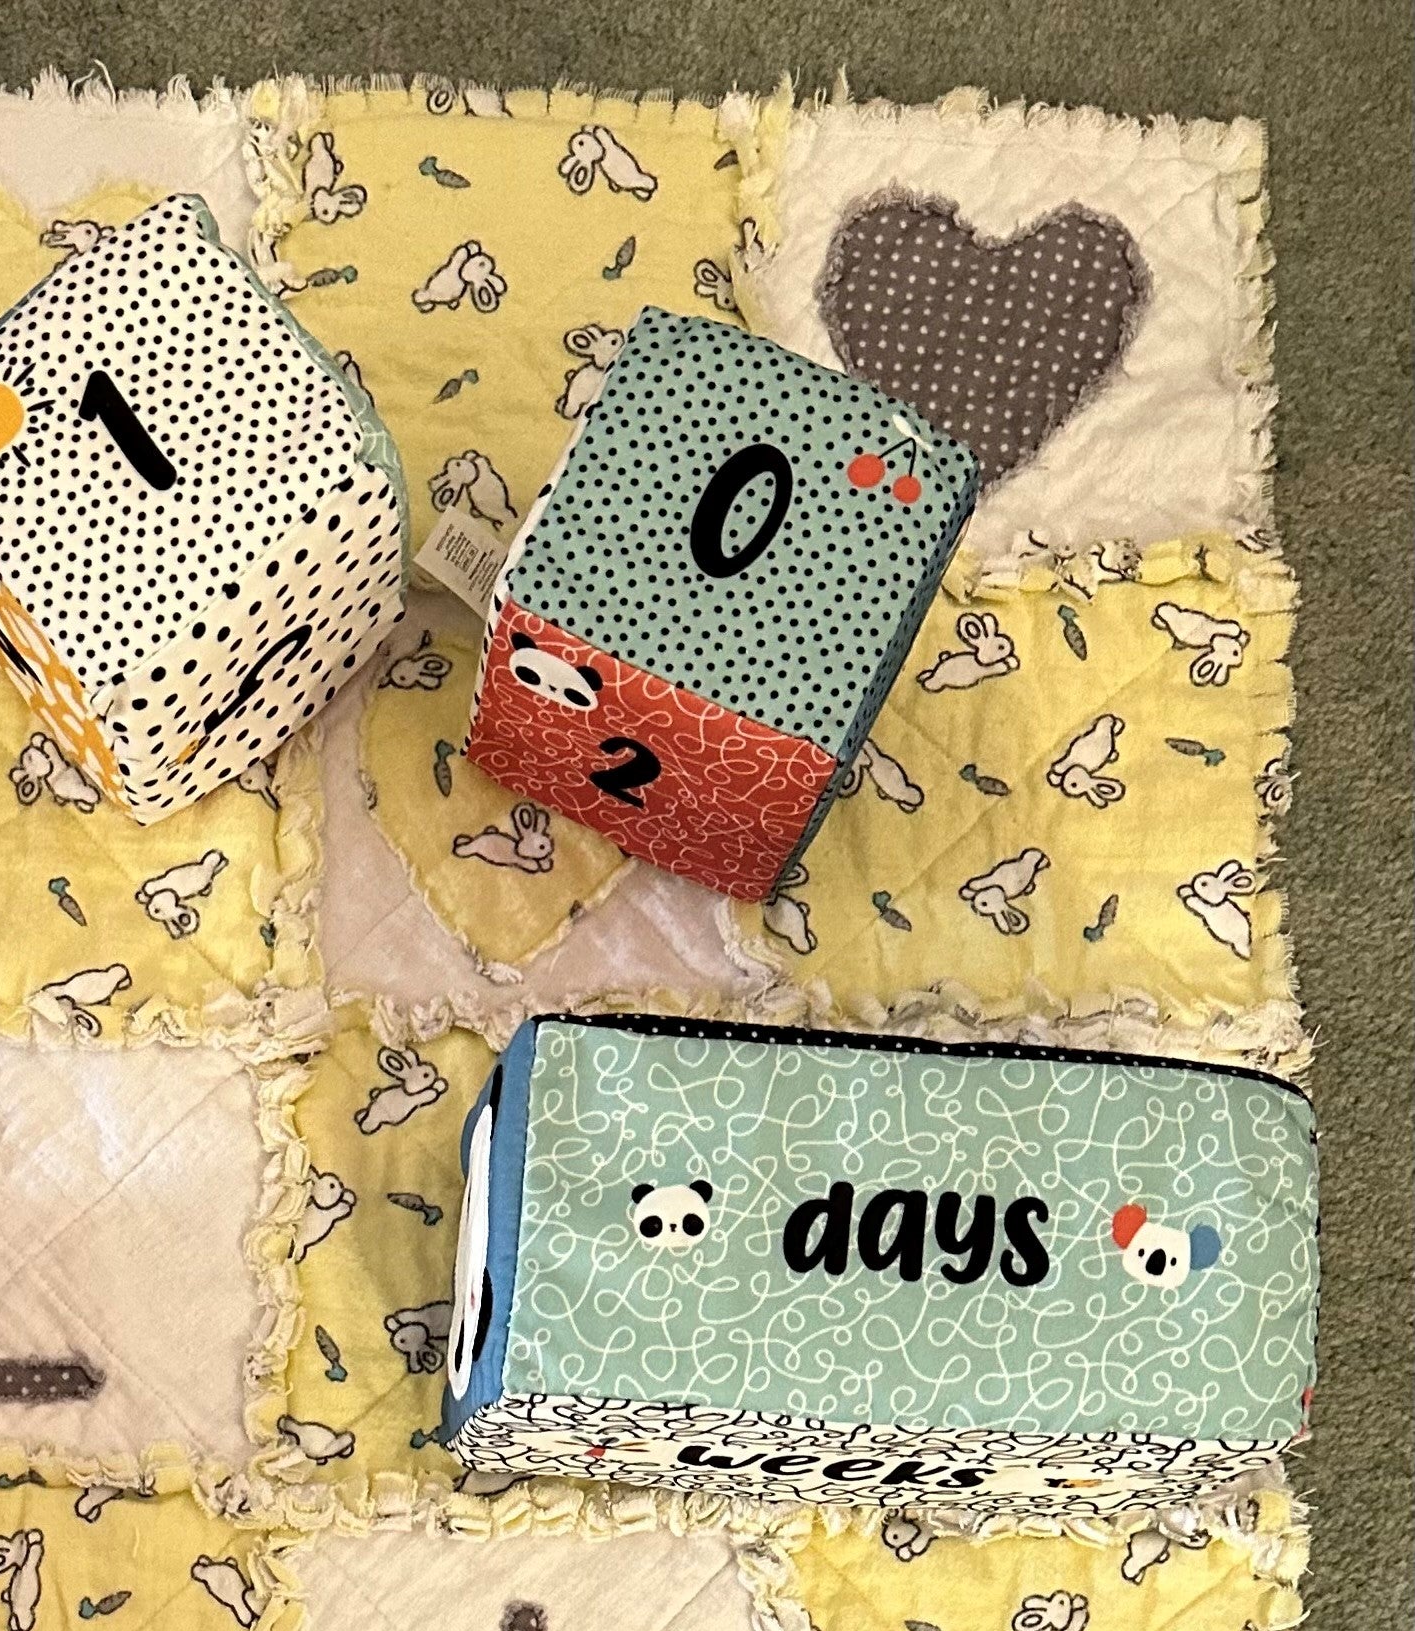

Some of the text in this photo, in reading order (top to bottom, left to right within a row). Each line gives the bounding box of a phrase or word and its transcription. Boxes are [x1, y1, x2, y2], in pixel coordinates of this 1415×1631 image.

[79, 371, 176, 490] 1
[690, 444, 792, 578] 0
[588, 737, 662, 810] 2
[783, 1181, 1051, 1287] days
[677, 1444, 997, 1489] weeks
